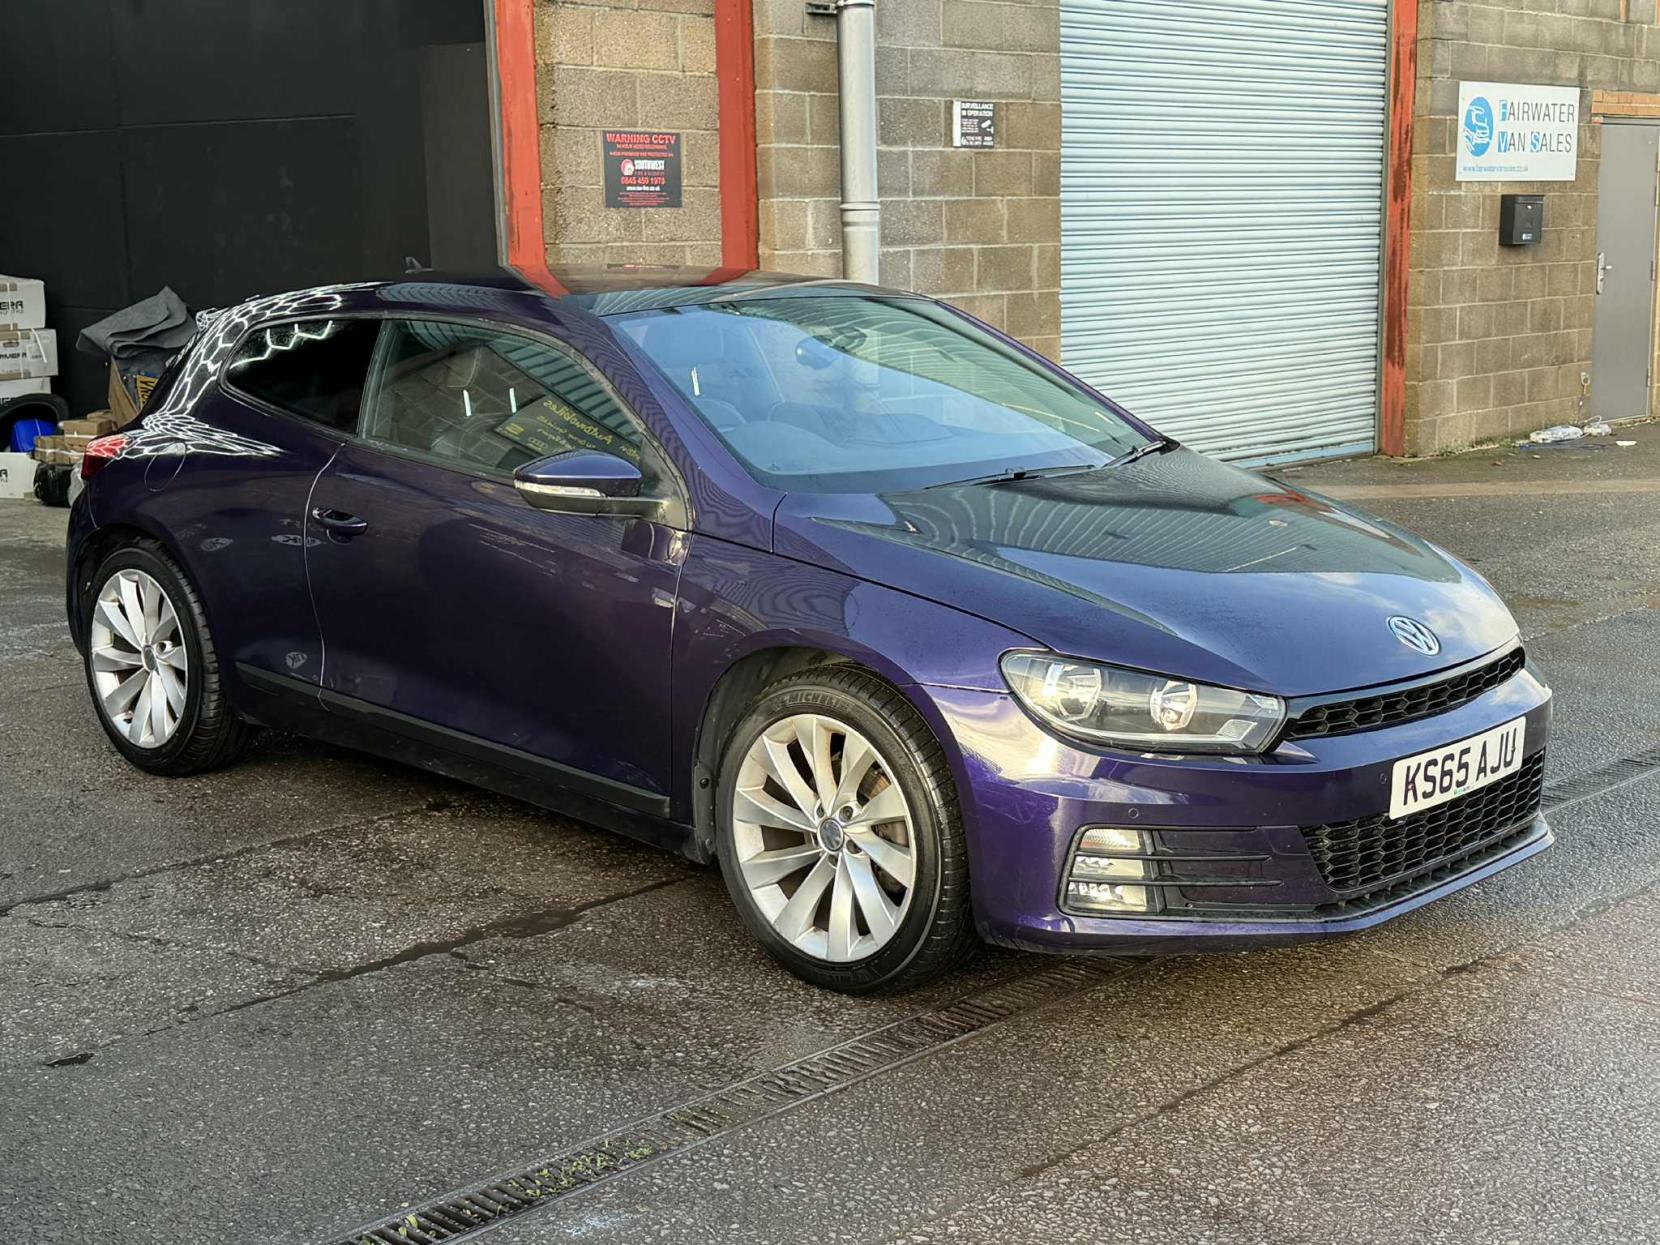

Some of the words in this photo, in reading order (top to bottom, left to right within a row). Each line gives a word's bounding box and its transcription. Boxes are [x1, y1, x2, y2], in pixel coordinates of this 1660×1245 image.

[1499, 99, 1575, 123] FAIRWATER
[606, 133, 650, 144] WARNING
[652, 134, 676, 145] CCTV
[1498, 131, 1526, 153] VAN
[1530, 131, 1572, 153] SALES
[1403, 746, 1472, 806] KS65
[1475, 727, 1517, 782] AJU
